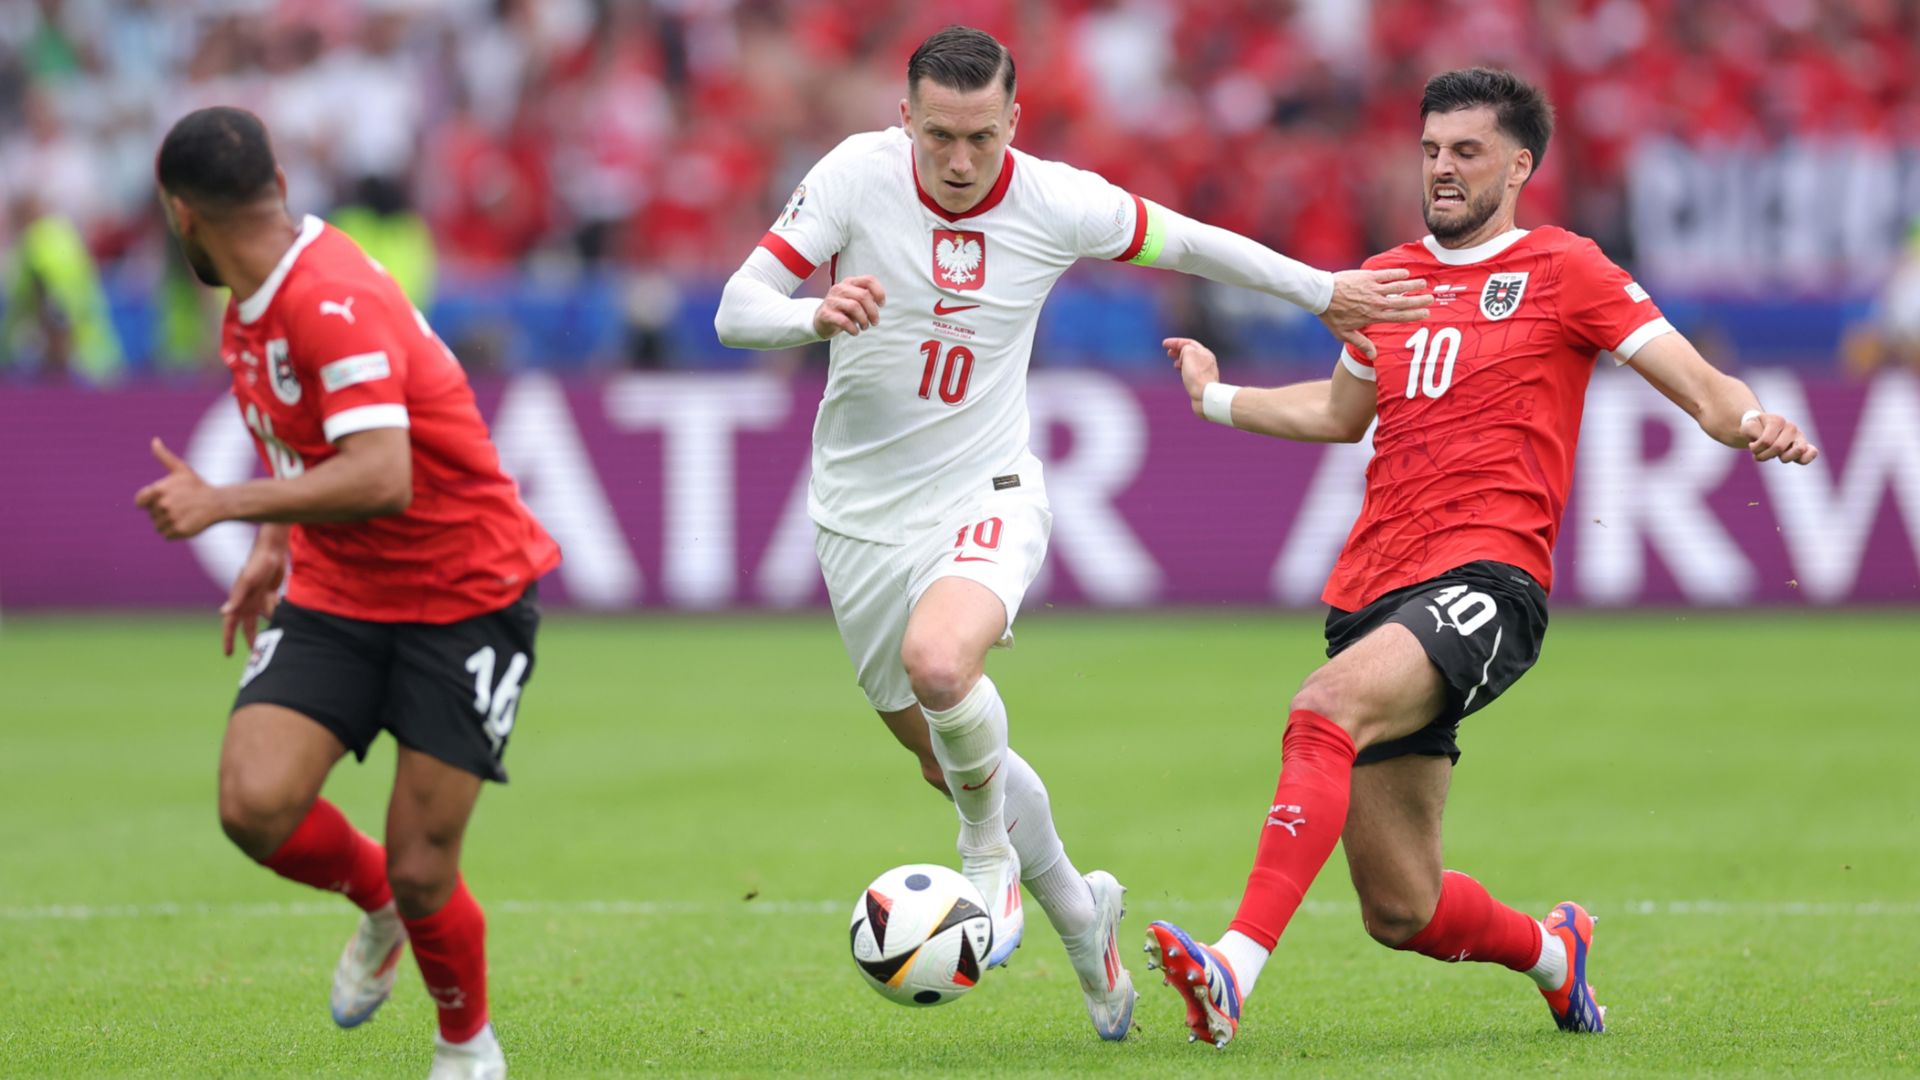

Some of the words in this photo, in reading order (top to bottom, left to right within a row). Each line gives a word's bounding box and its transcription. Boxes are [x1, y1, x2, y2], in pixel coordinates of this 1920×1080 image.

[918, 340, 976, 407] 10
[1404, 326, 1462, 399] 10
[954, 516, 1003, 551] 10
[1433, 584, 1498, 636] 10
[465, 645, 528, 737] 16
